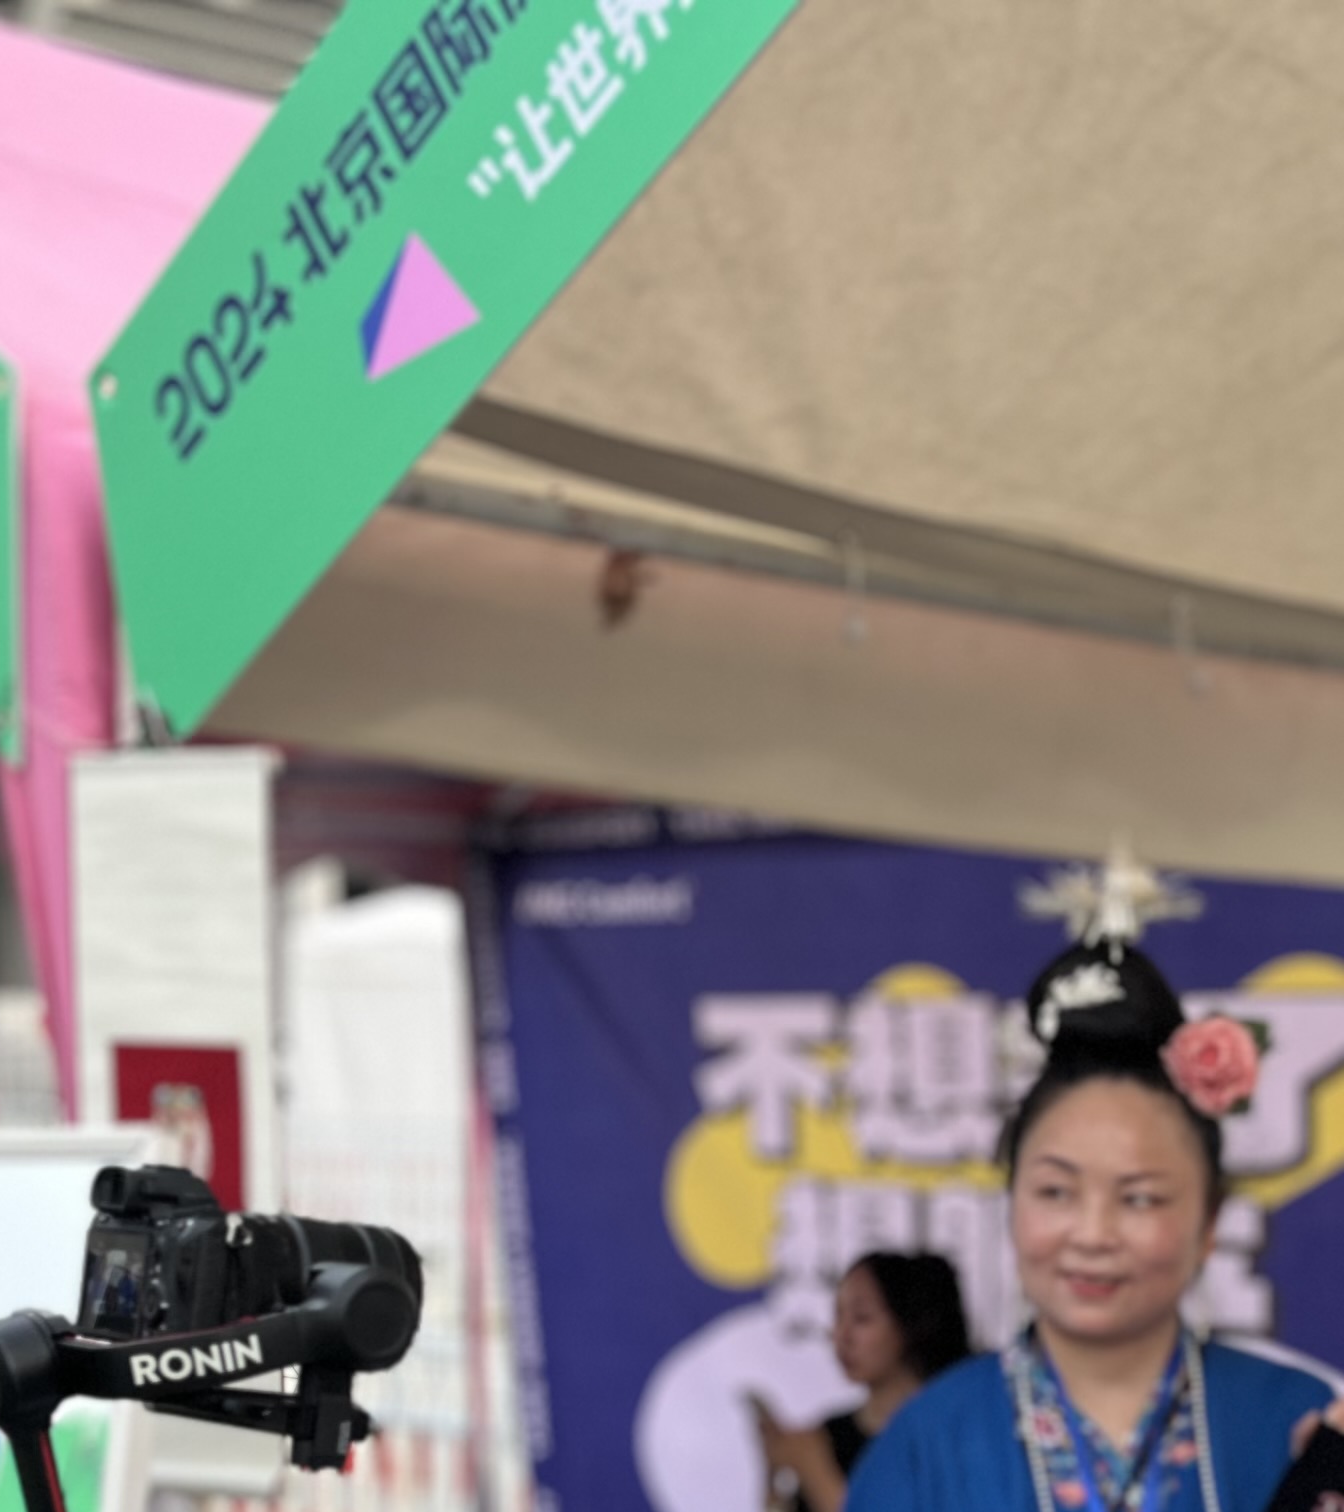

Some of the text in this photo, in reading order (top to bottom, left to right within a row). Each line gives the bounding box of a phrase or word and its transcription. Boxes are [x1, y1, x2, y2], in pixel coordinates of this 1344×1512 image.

[152, 0, 531, 464] 2024 北京国际
[129, 1333, 264, 1386] RONIN
